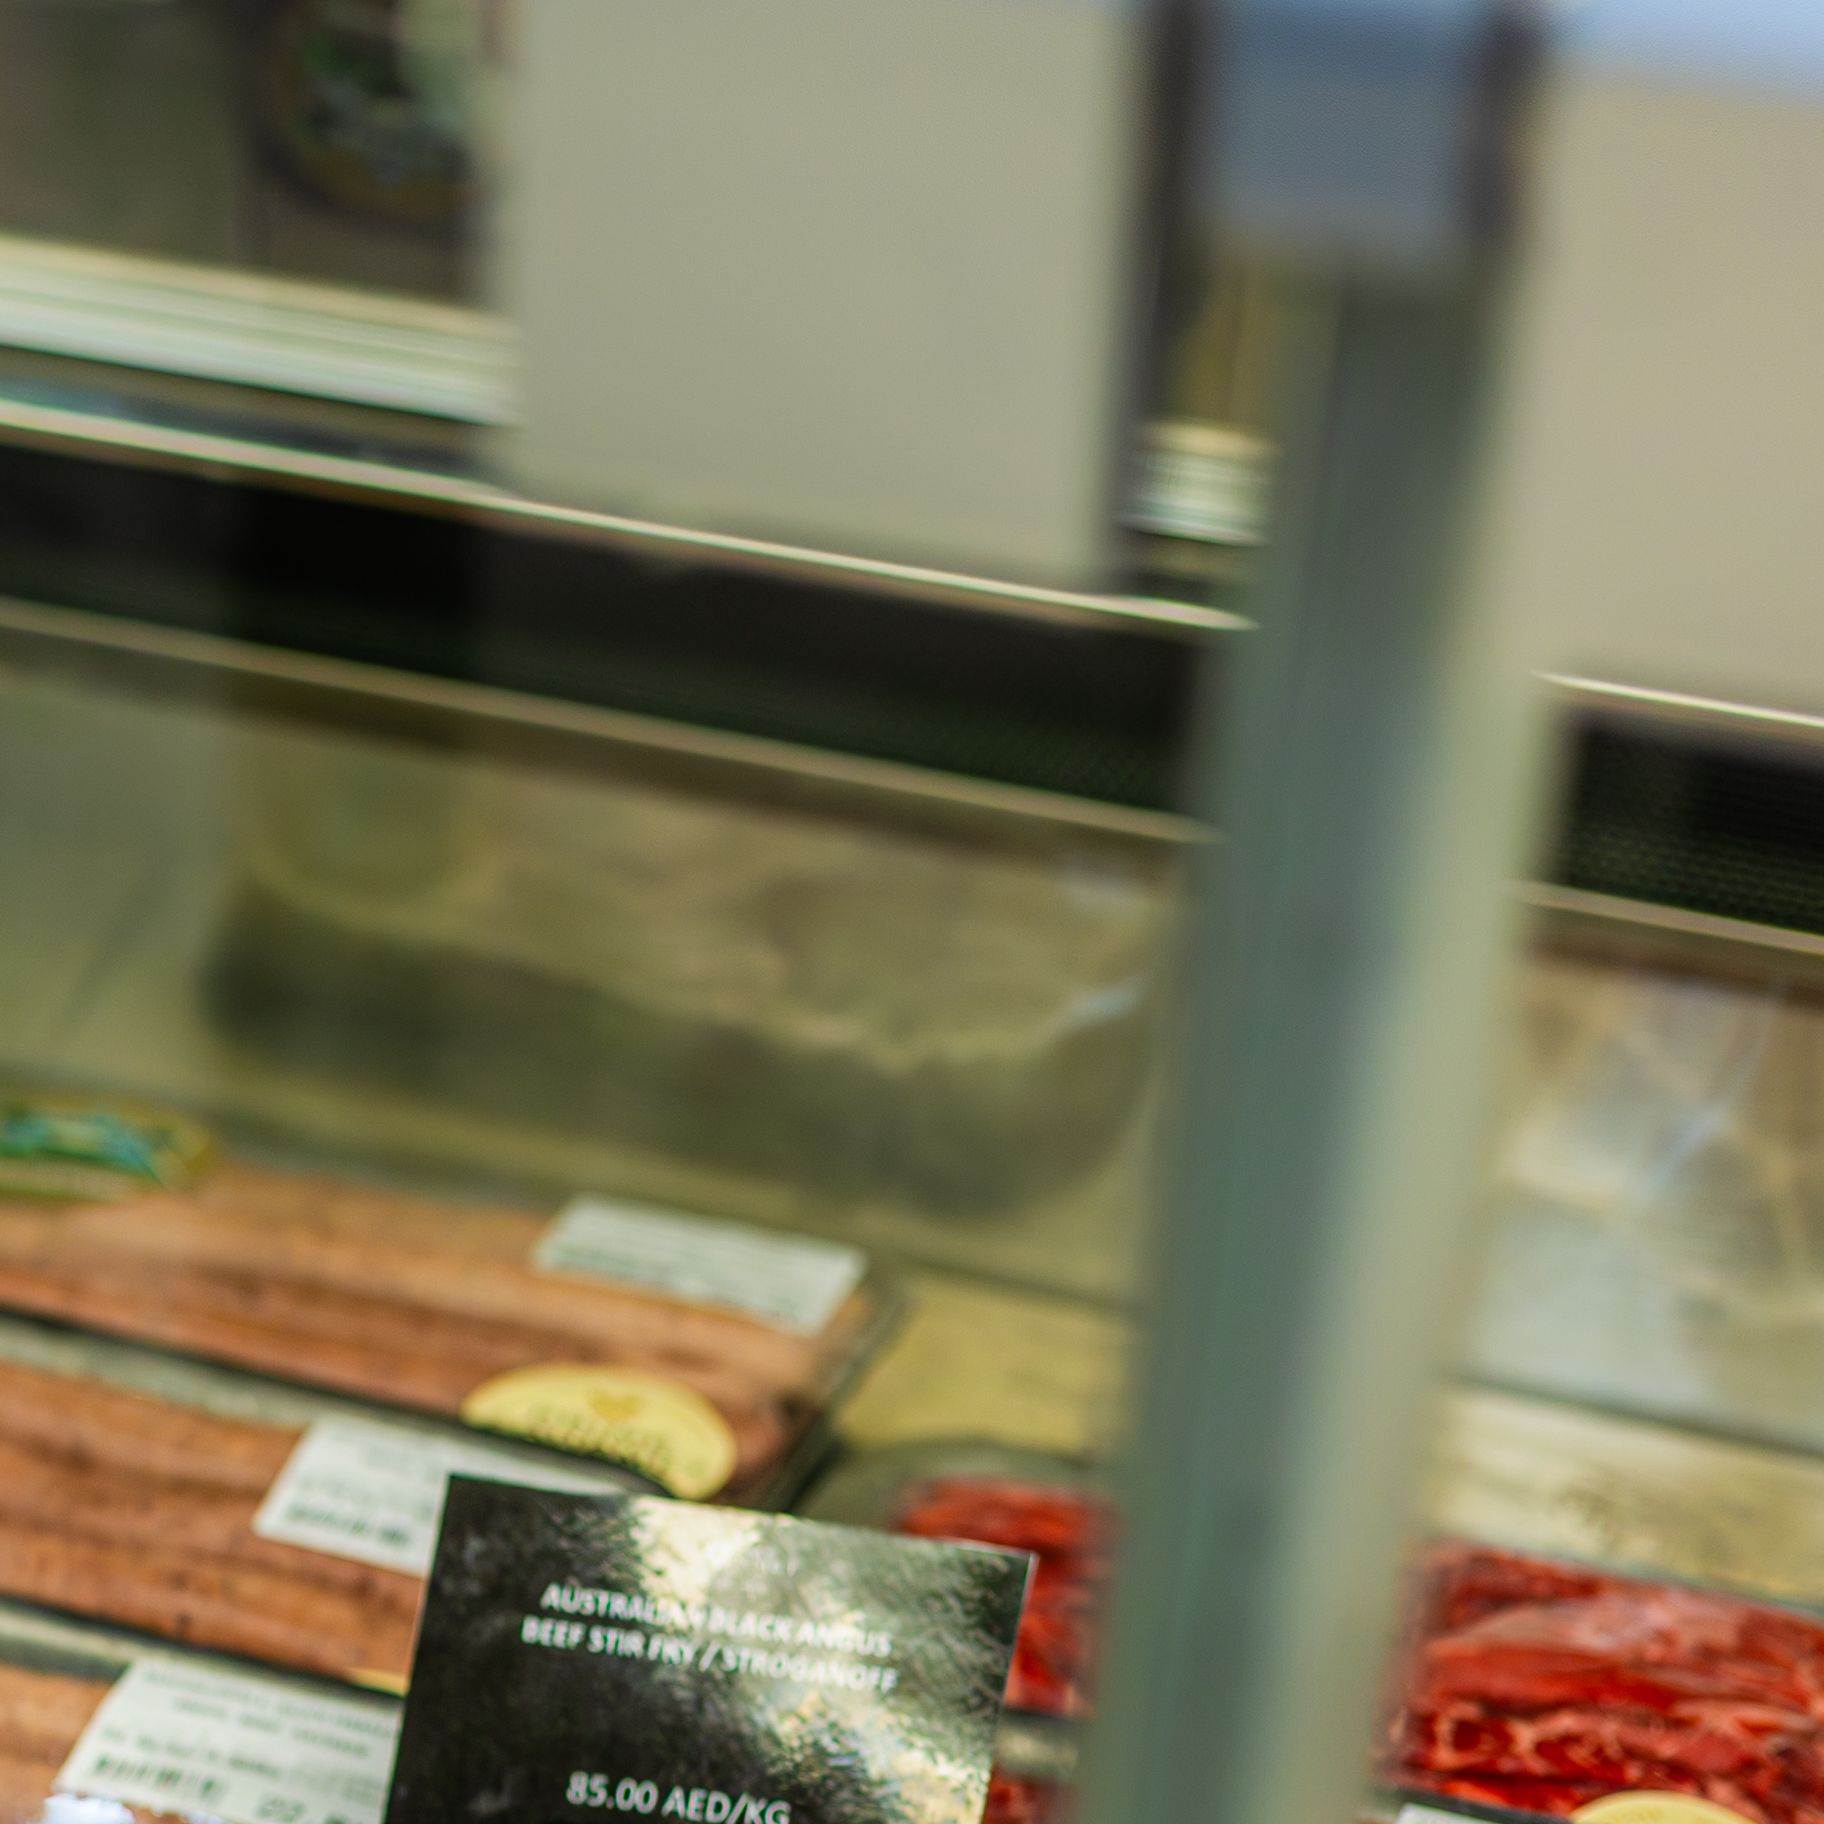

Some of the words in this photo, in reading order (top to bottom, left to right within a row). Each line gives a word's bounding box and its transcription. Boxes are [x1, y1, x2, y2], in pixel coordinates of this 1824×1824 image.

[709, 1606, 793, 1642] BLACK
[521, 1615, 584, 1649] BEEF
[588, 1625, 645, 1658] STIR
[648, 1633, 696, 1665] FRY
[722, 1644, 897, 1693] STROGANOFF
[566, 1771, 658, 1814] 85.00
